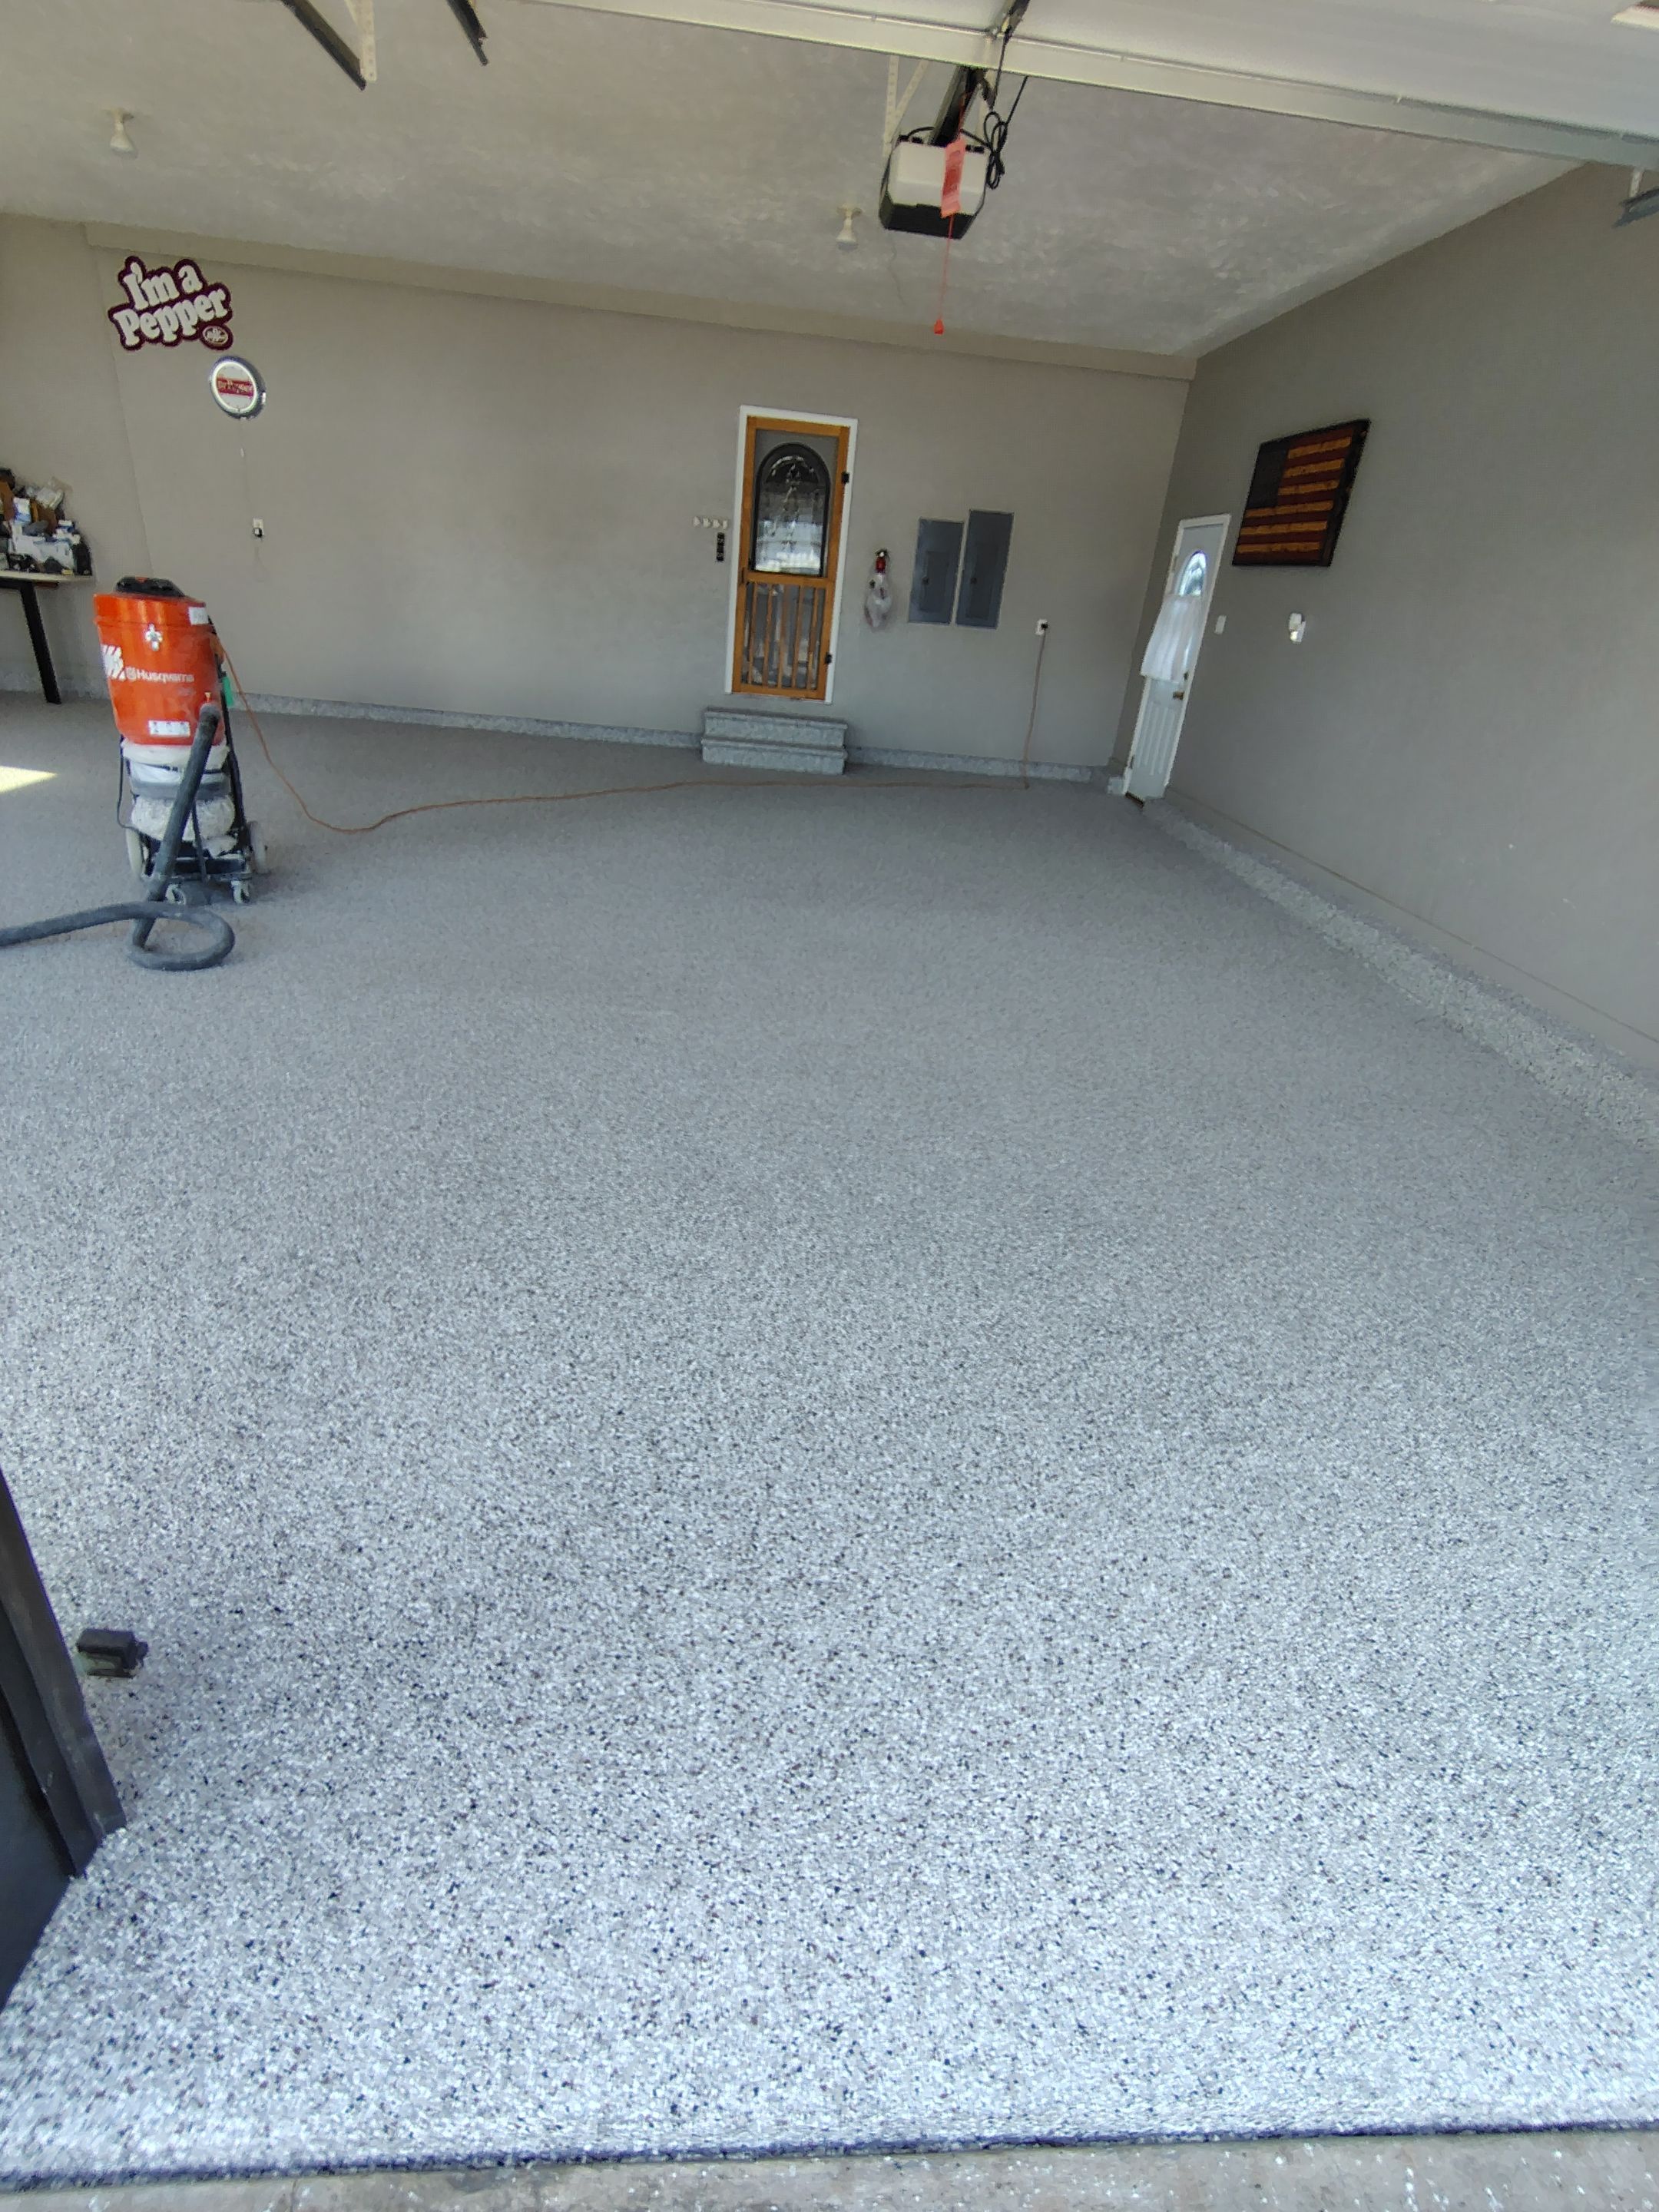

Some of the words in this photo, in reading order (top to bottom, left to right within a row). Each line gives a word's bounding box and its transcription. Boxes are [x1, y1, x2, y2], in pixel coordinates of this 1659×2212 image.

[123, 262, 180, 310] I'm
[178, 265, 204, 293] a
[113, 288, 228, 346] Pepper
